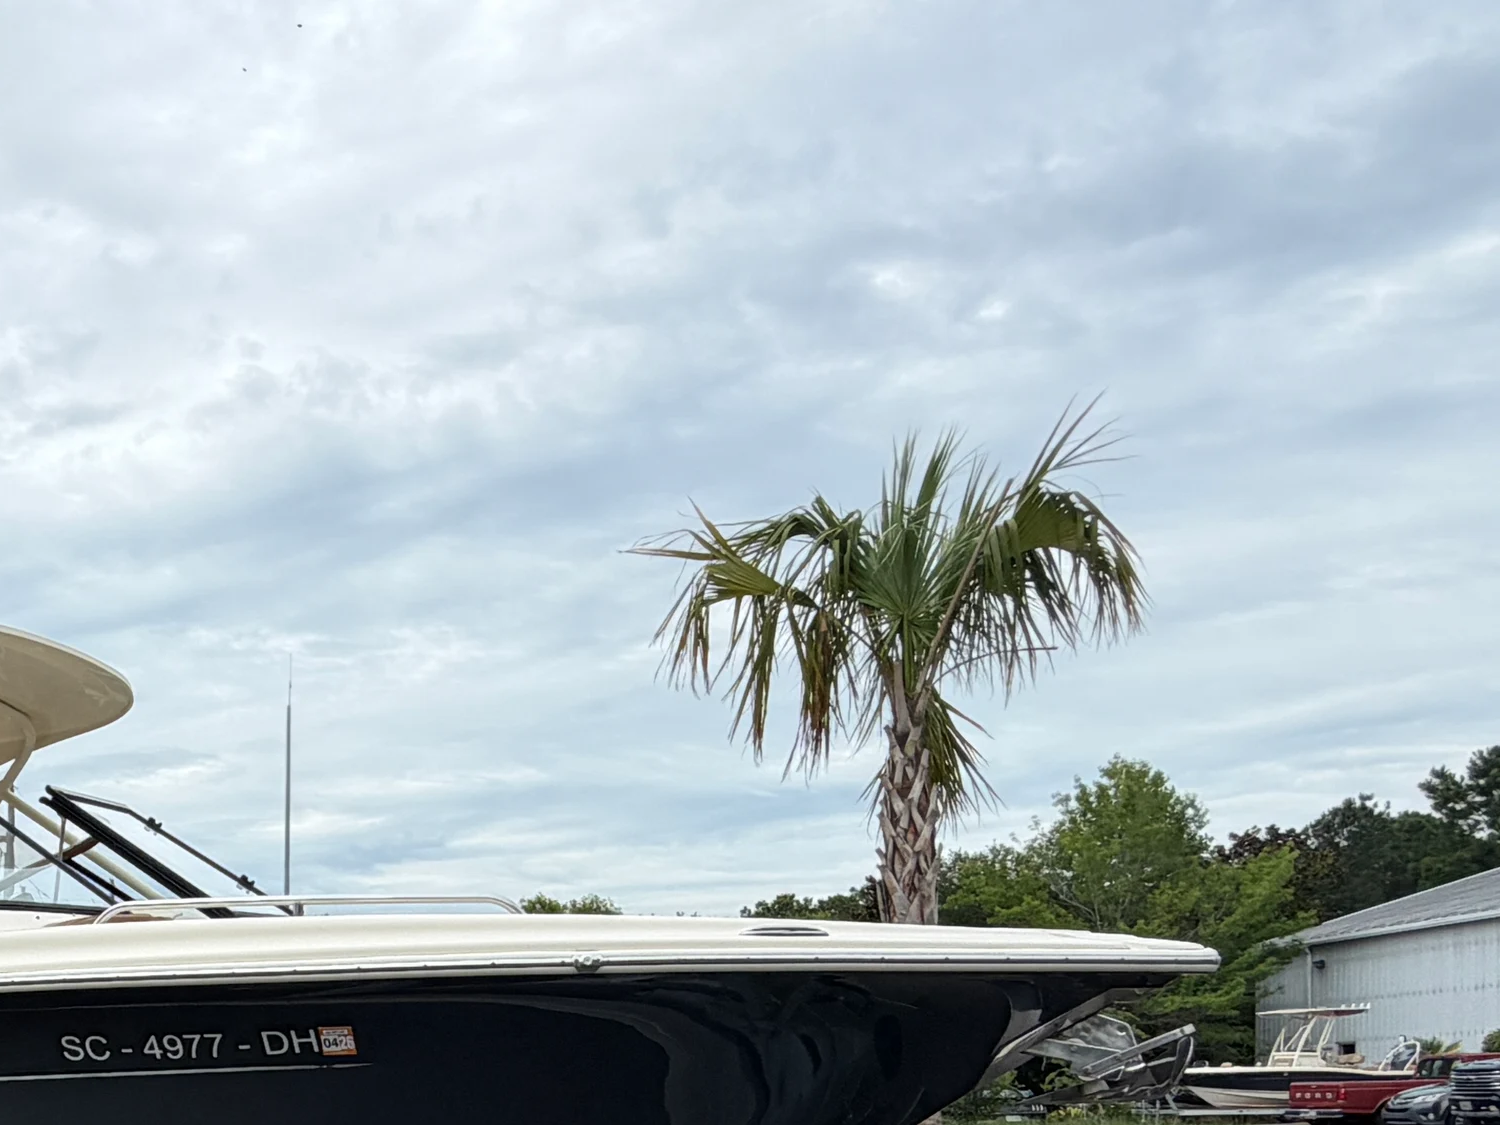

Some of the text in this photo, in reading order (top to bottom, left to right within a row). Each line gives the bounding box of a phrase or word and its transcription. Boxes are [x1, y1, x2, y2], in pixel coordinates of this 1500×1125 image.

[60, 1035, 111, 1061] SC
[143, 1033, 223, 1061] 4977
[261, 1029, 320, 1056] DH
